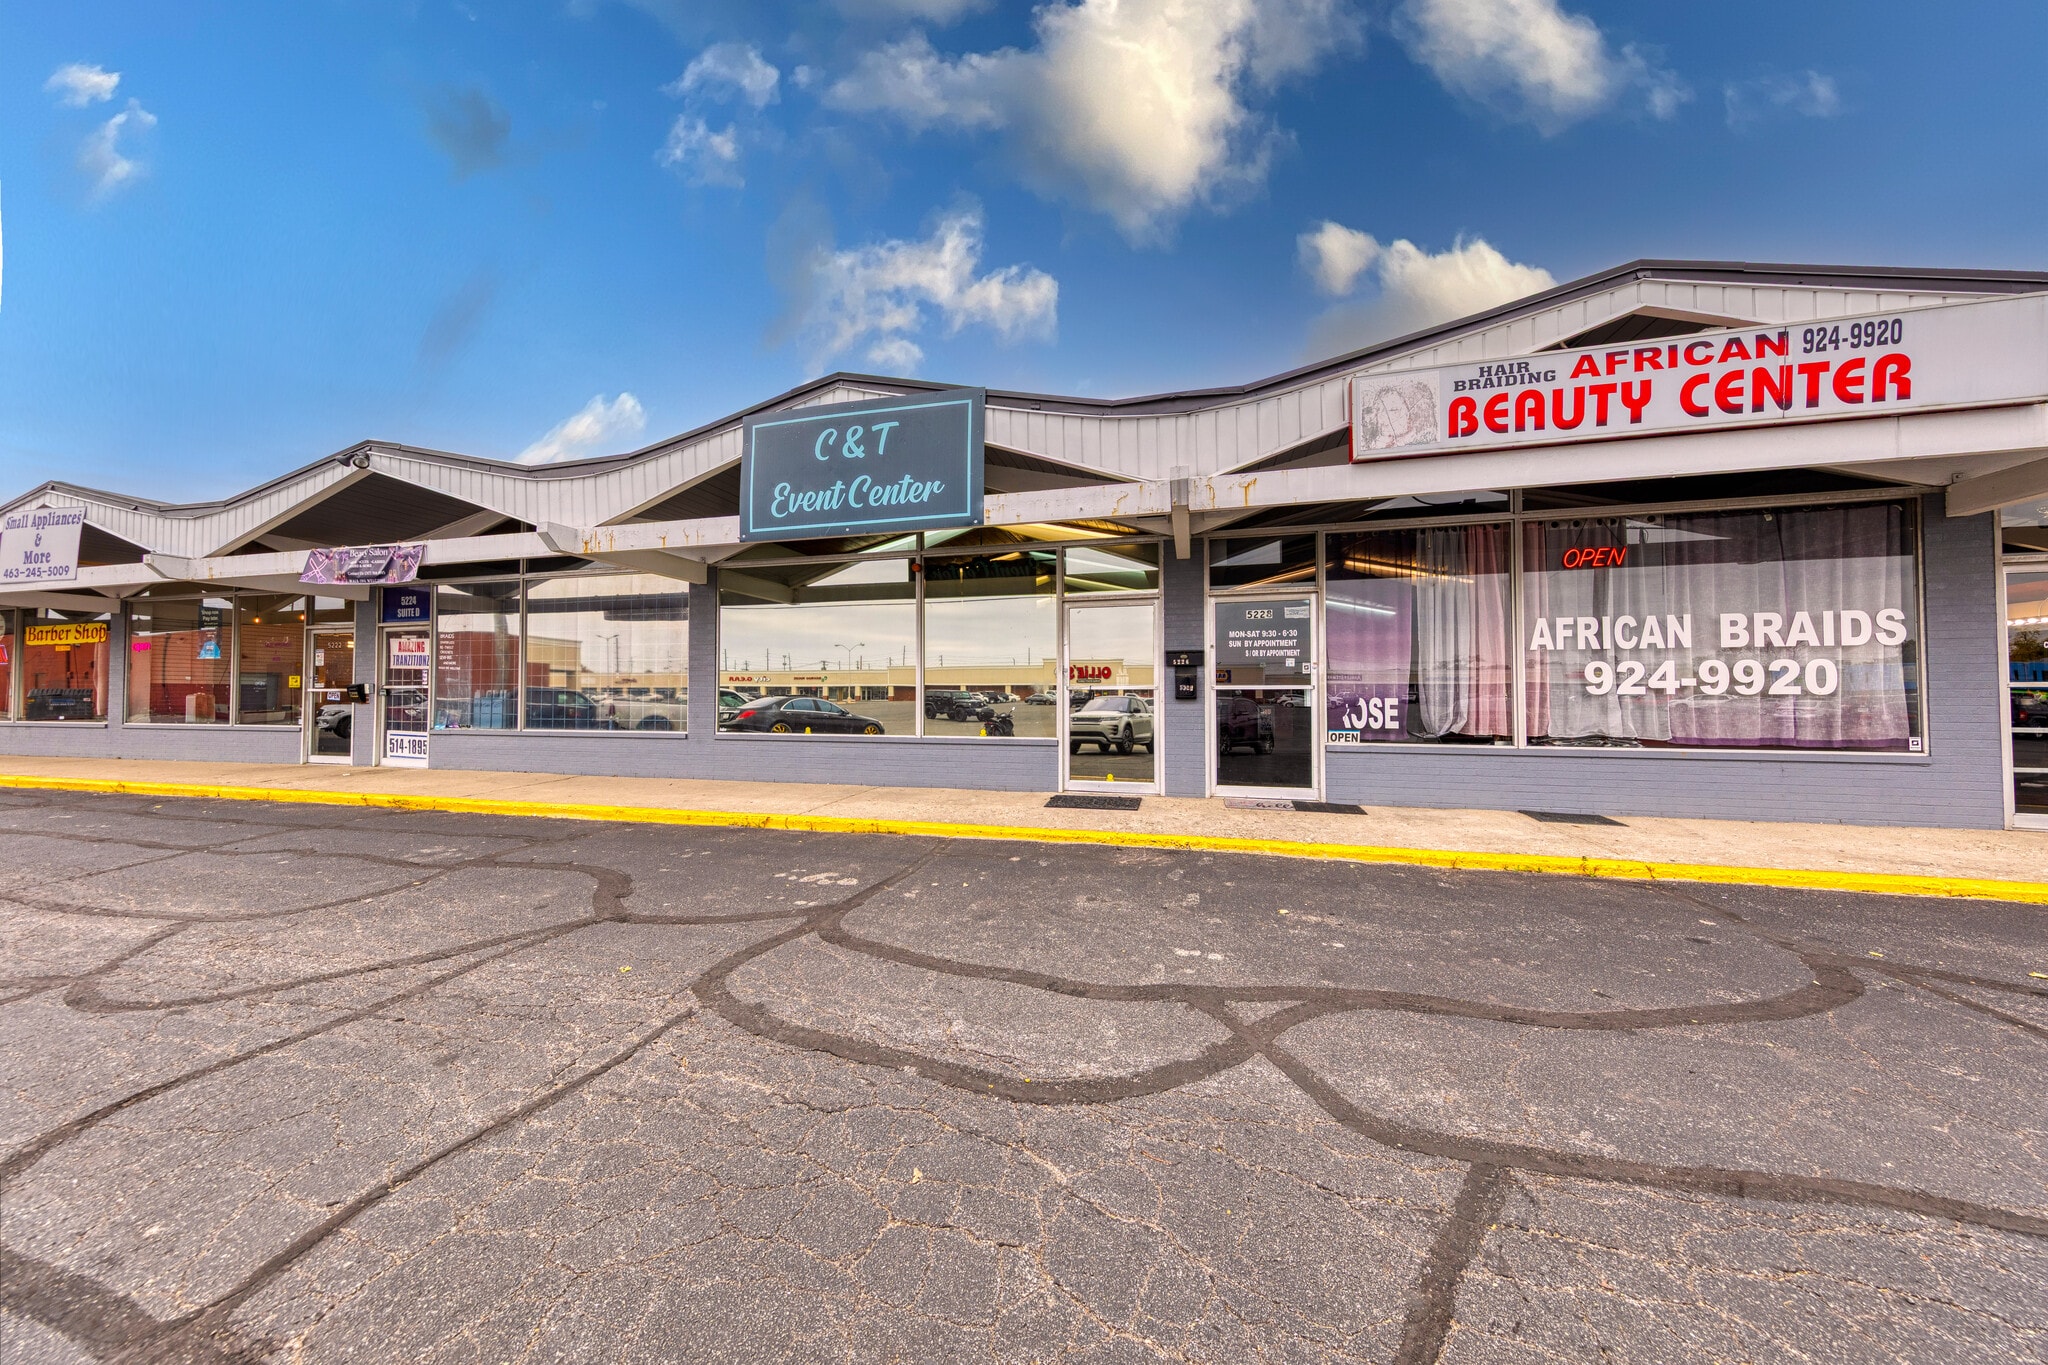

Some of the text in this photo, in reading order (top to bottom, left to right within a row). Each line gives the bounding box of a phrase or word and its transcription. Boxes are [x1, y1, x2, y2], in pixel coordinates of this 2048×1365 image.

[1802, 318, 1903, 354] 924-9920
[1569, 331, 1789, 379] AFRICAN
[1478, 361, 1530, 378] HAIR
[1453, 370, 1556, 392] BRAIDING
[1447, 353, 1911, 439] BEAUTY CENTER
[814, 421, 900, 461] C & T
[770, 474, 945, 518] Event Center
[5, 511, 82, 530] Small Appliances
[34, 533, 42, 547] &
[23, 550, 51, 564] More
[369, 547, 388, 557] Salon
[1562, 546, 1627, 569] OPEN
[3, 565, 70, 579] 463-245-5009
[401, 596, 417, 606] 5224
[397, 608, 420, 617] SUITE D
[1246, 610, 1272, 619] 5228
[27, 623, 106, 642] Barber Shop
[1228, 630, 1260, 638] MON-SAT
[1530, 608, 1908, 650] AFRICAN BRAIDS
[398, 641, 425, 653] AMAZING
[1228, 640, 1241, 648] SUN
[1253, 639, 1297, 647] APPOINTMENT
[1266, 649, 1300, 657] APPOINTMENT
[1584, 658, 1838, 695] 924-9920
[389, 738, 427, 755] 514-1895
[1330, 733, 1359, 743] OPEN
